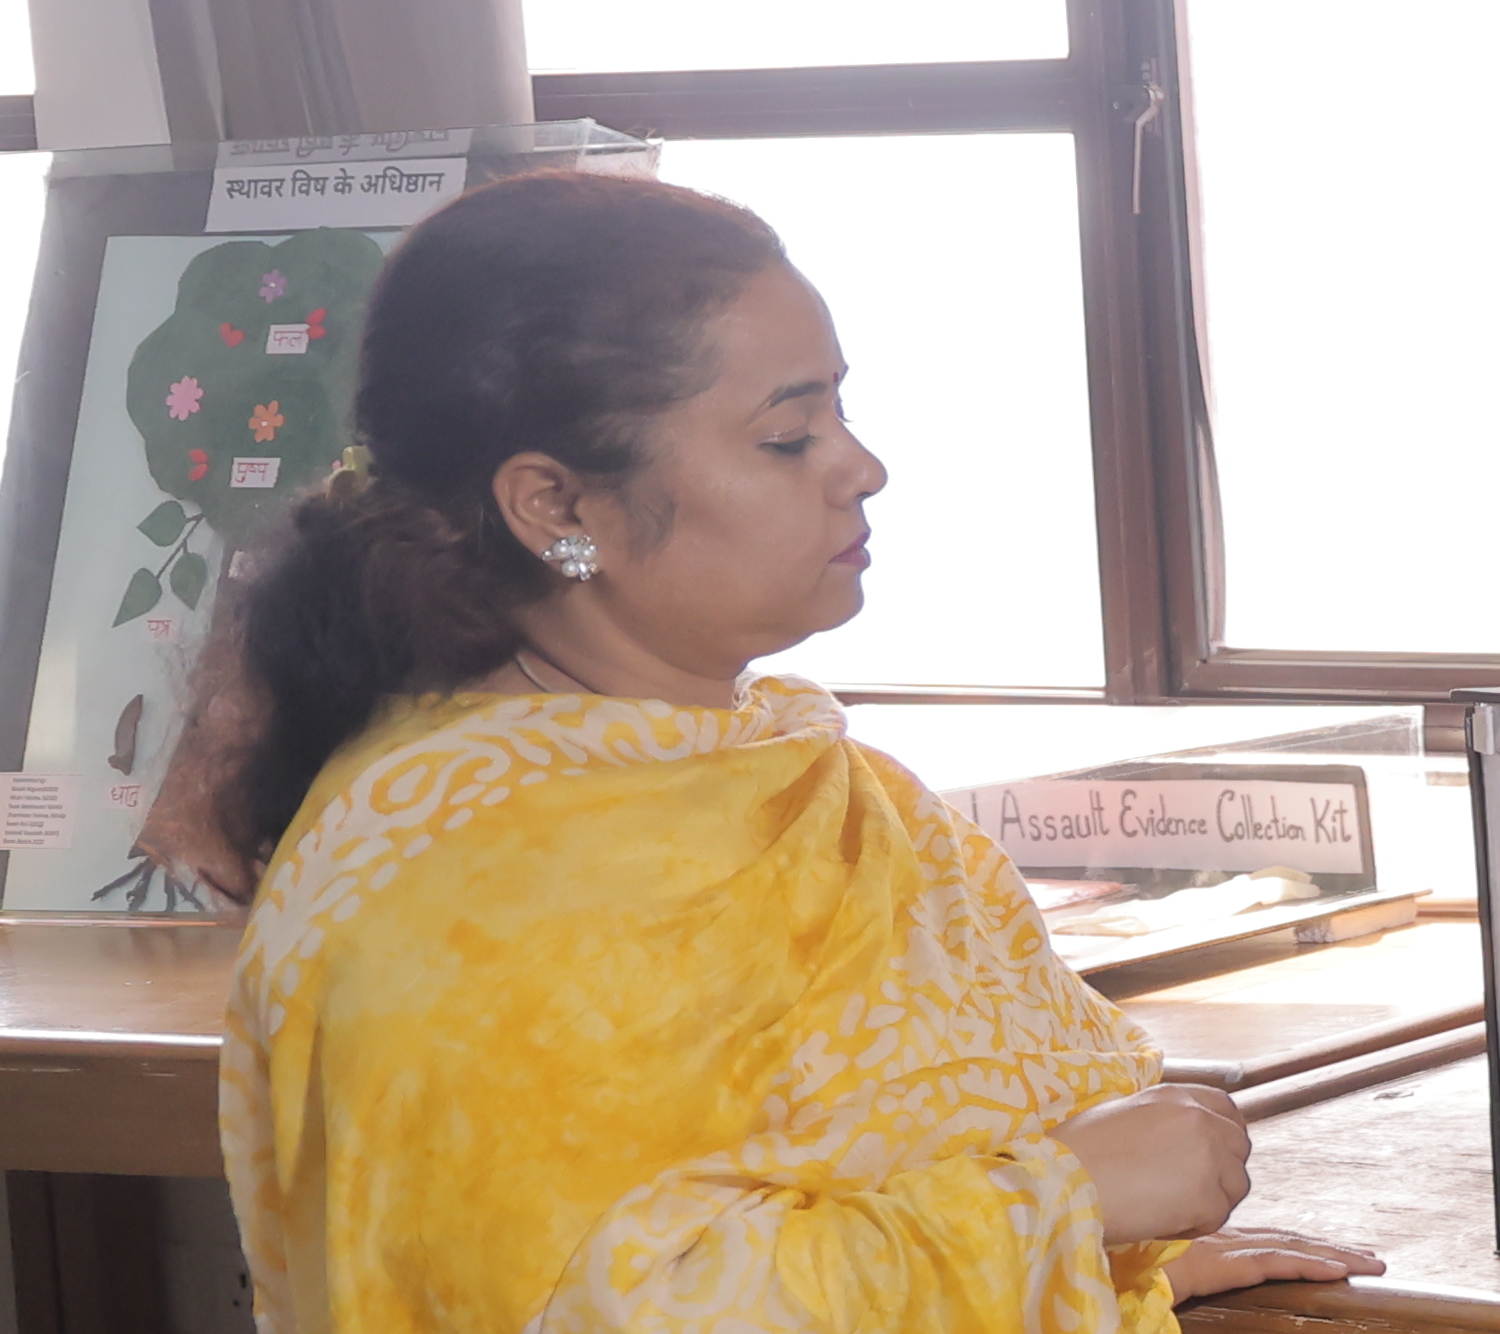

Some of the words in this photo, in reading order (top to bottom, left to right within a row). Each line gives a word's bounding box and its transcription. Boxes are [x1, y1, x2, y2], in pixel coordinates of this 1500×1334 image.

[1000, 788, 1110, 843] Assault
[1117, 789, 1208, 838] Evidence
[1215, 789, 1305, 842] Collection
[1310, 796, 1353, 845] Kit
